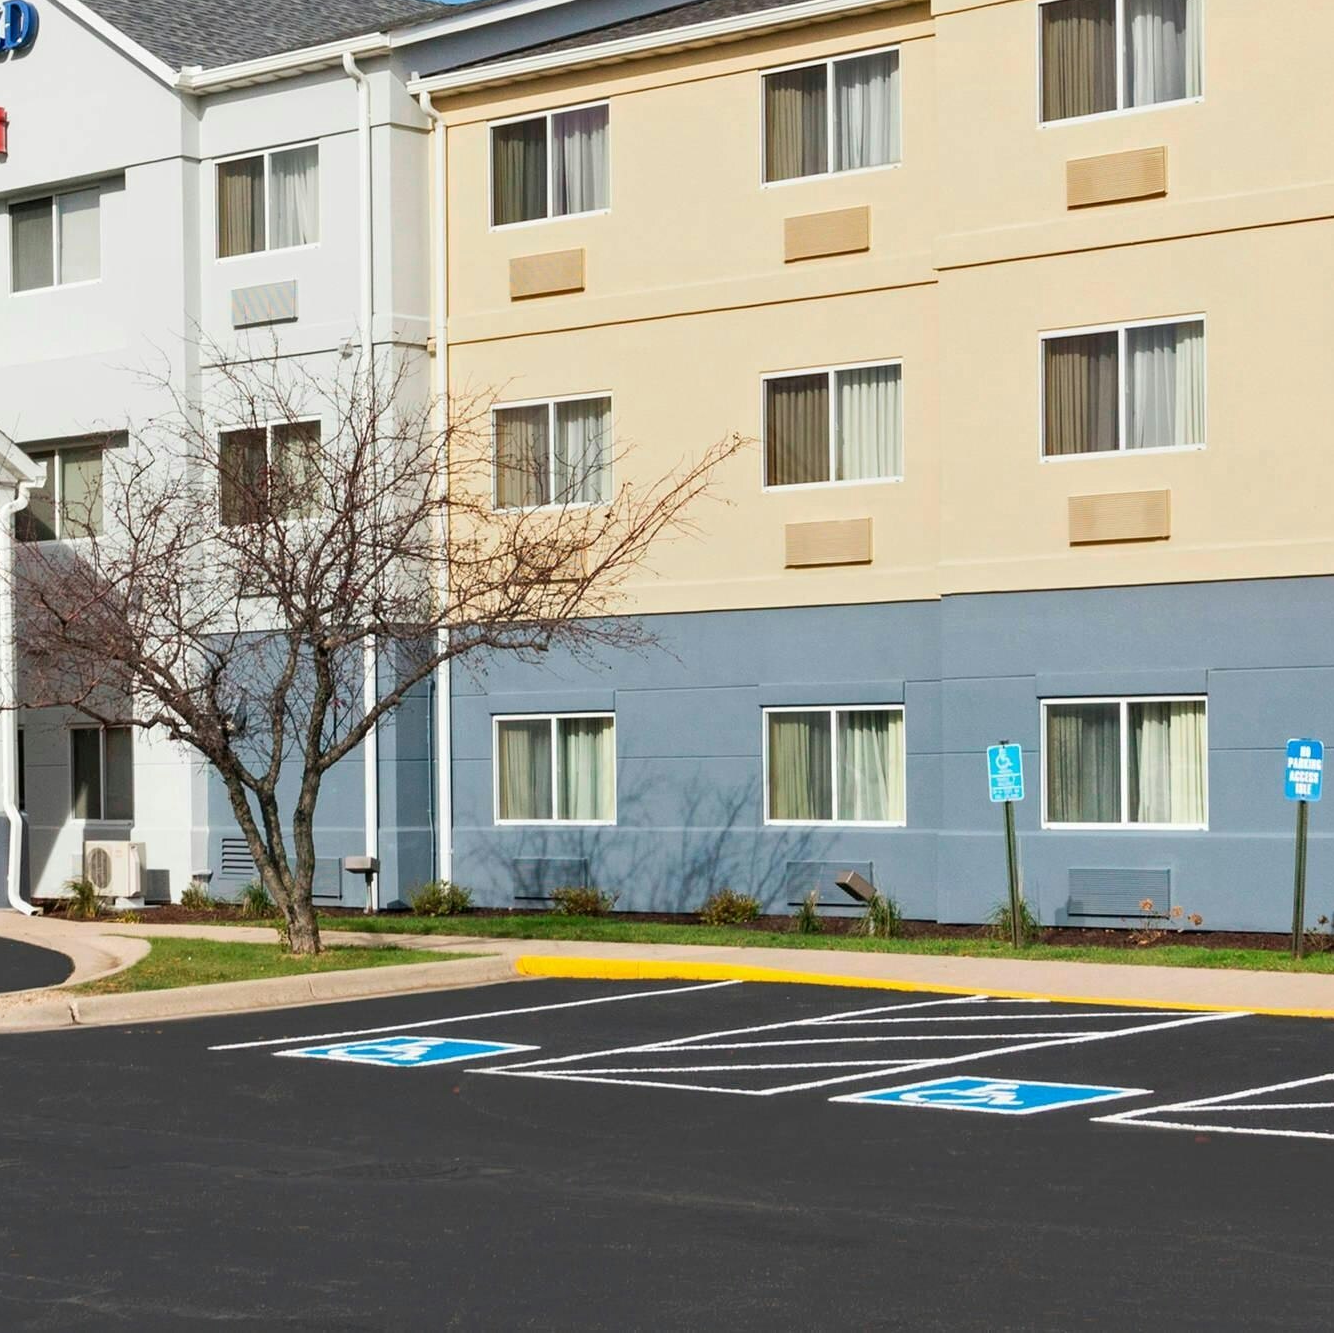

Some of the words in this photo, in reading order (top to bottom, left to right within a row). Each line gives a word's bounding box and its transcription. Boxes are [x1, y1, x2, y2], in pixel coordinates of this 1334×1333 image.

[1299, 746, 1312, 758] NO
[1287, 757, 1322, 771] PARKING
[1289, 770, 1319, 784] ACCESS
